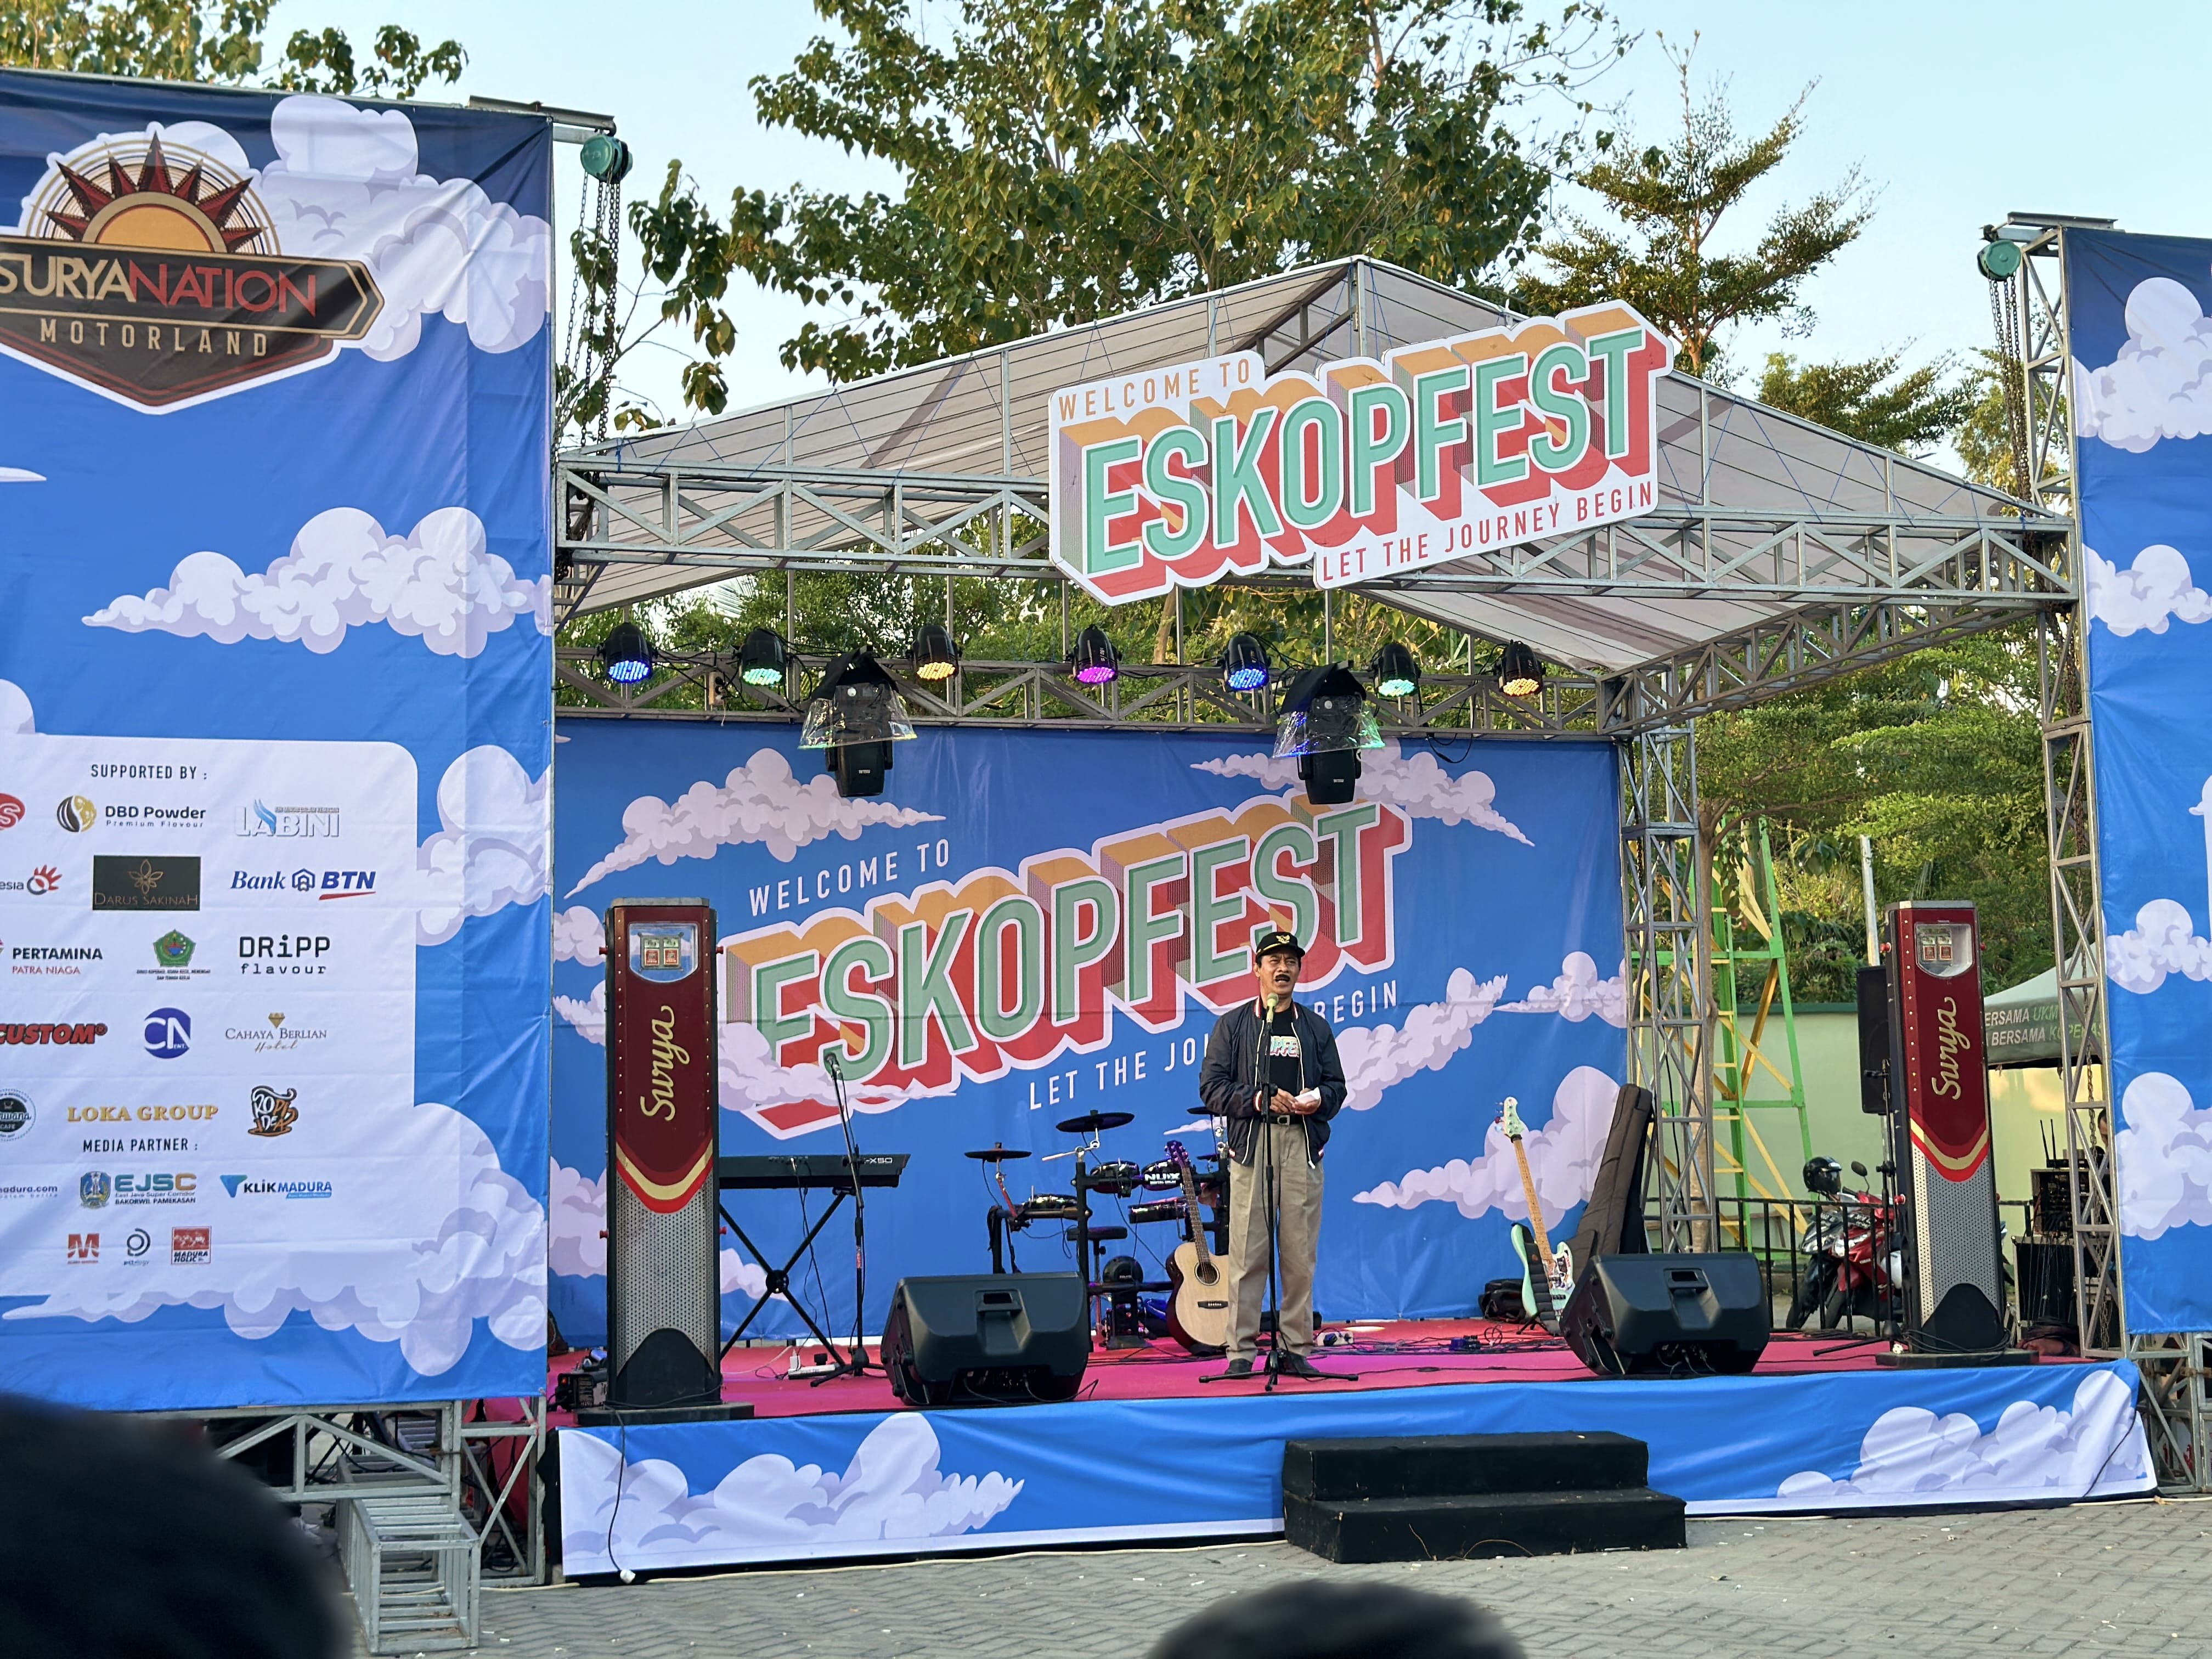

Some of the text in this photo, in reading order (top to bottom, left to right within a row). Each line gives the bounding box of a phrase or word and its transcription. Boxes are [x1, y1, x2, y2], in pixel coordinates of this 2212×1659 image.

[40, 318, 267, 357] MOTORLAND
[1058, 357, 1251, 422] WELCOME TO
[1084, 327, 1645, 577] ESKOPFEST
[1322, 481, 1653, 583] LET THE JOURNEY BEGIN
[91, 764, 172, 779] SUPPORTED
[180, 766, 197, 779] BY
[105, 805, 206, 819] DBD Powder
[230, 870, 376, 889] Bank BTN
[749, 839, 950, 917] WELCOME TO
[94, 892, 199, 905] DARUS SAKINAH
[239, 934, 330, 958] DRiPP
[755, 803, 1379, 1082] ESKOPFEST
[12, 947, 103, 960] PERTAMINA
[12, 965, 81, 974] PATRA NIAGA
[241, 963, 326, 975] flavour
[1314, 980, 1397, 1024] BEGIN
[1985, 1008, 2030, 1027] ERSAMA
[225, 1028, 327, 1040] CAHAYA BERLIAN
[1991, 1027, 2046, 1046] BERSAMA
[1931, 996, 1971, 1100] Surya
[640, 1005, 690, 1121] Surya
[1029, 1070, 1079, 1110] LET
[1096, 1050, 1147, 1091] THE
[67, 1104, 218, 1122] LOKA GROUP
[83, 1139, 124, 1153] MEDIA
[131, 1138, 188, 1152] PARTNER
[115, 1173, 197, 1192] EJSC
